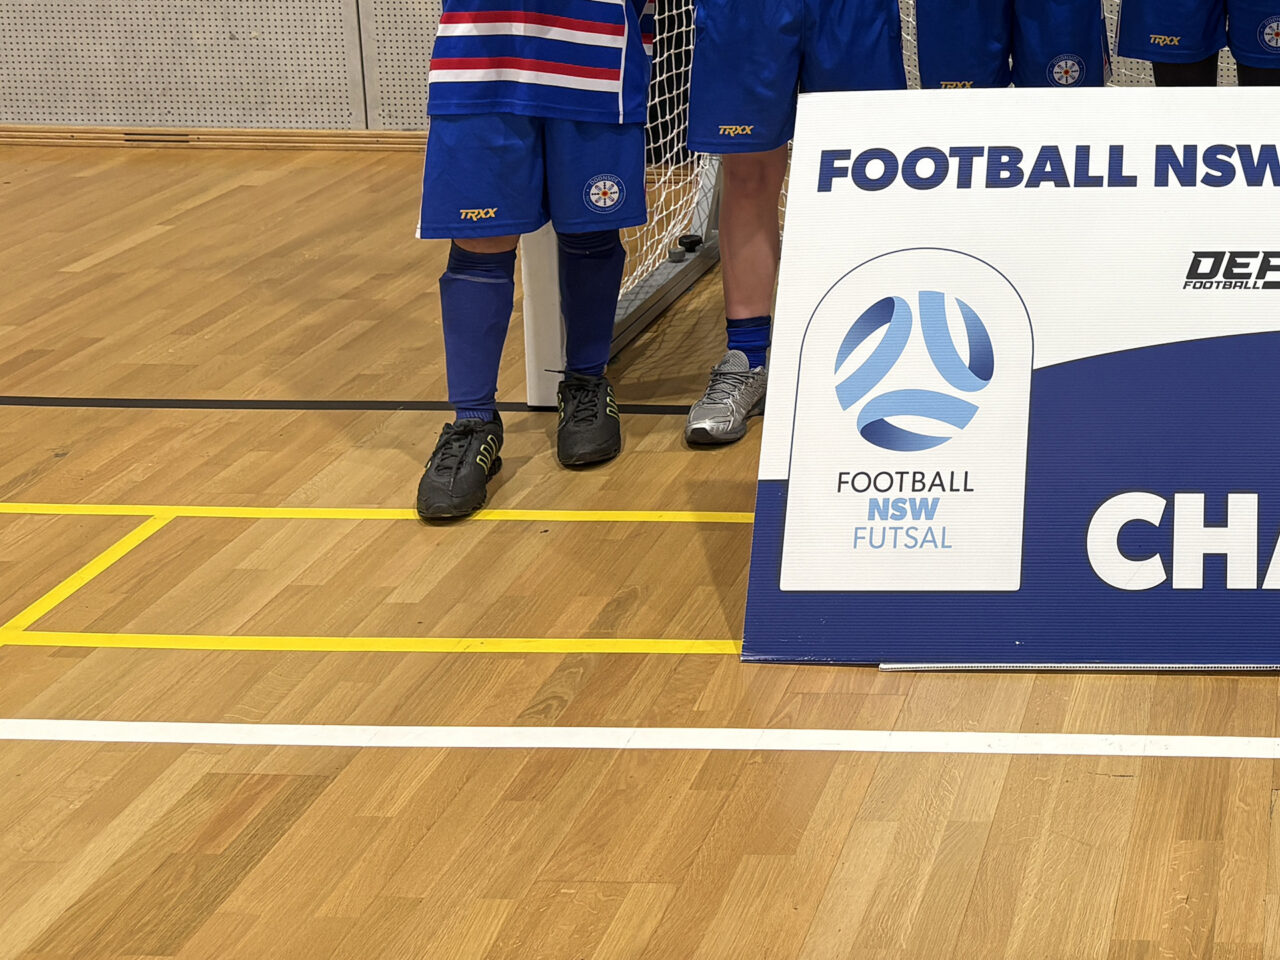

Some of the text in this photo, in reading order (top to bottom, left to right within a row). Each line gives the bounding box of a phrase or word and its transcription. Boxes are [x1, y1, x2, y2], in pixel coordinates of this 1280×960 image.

[1150, 35, 1181, 47] TRXX
[719, 125, 754, 137] TRXX
[818, 144, 1138, 193] FOOTBALL
[460, 207, 498, 221] TRXX
[1182, 280, 1261, 290] FOOTBALL
[837, 470, 974, 493] FOOTBALL
[867, 497, 941, 522] NSW
[853, 525, 953, 550] FUTSAL
